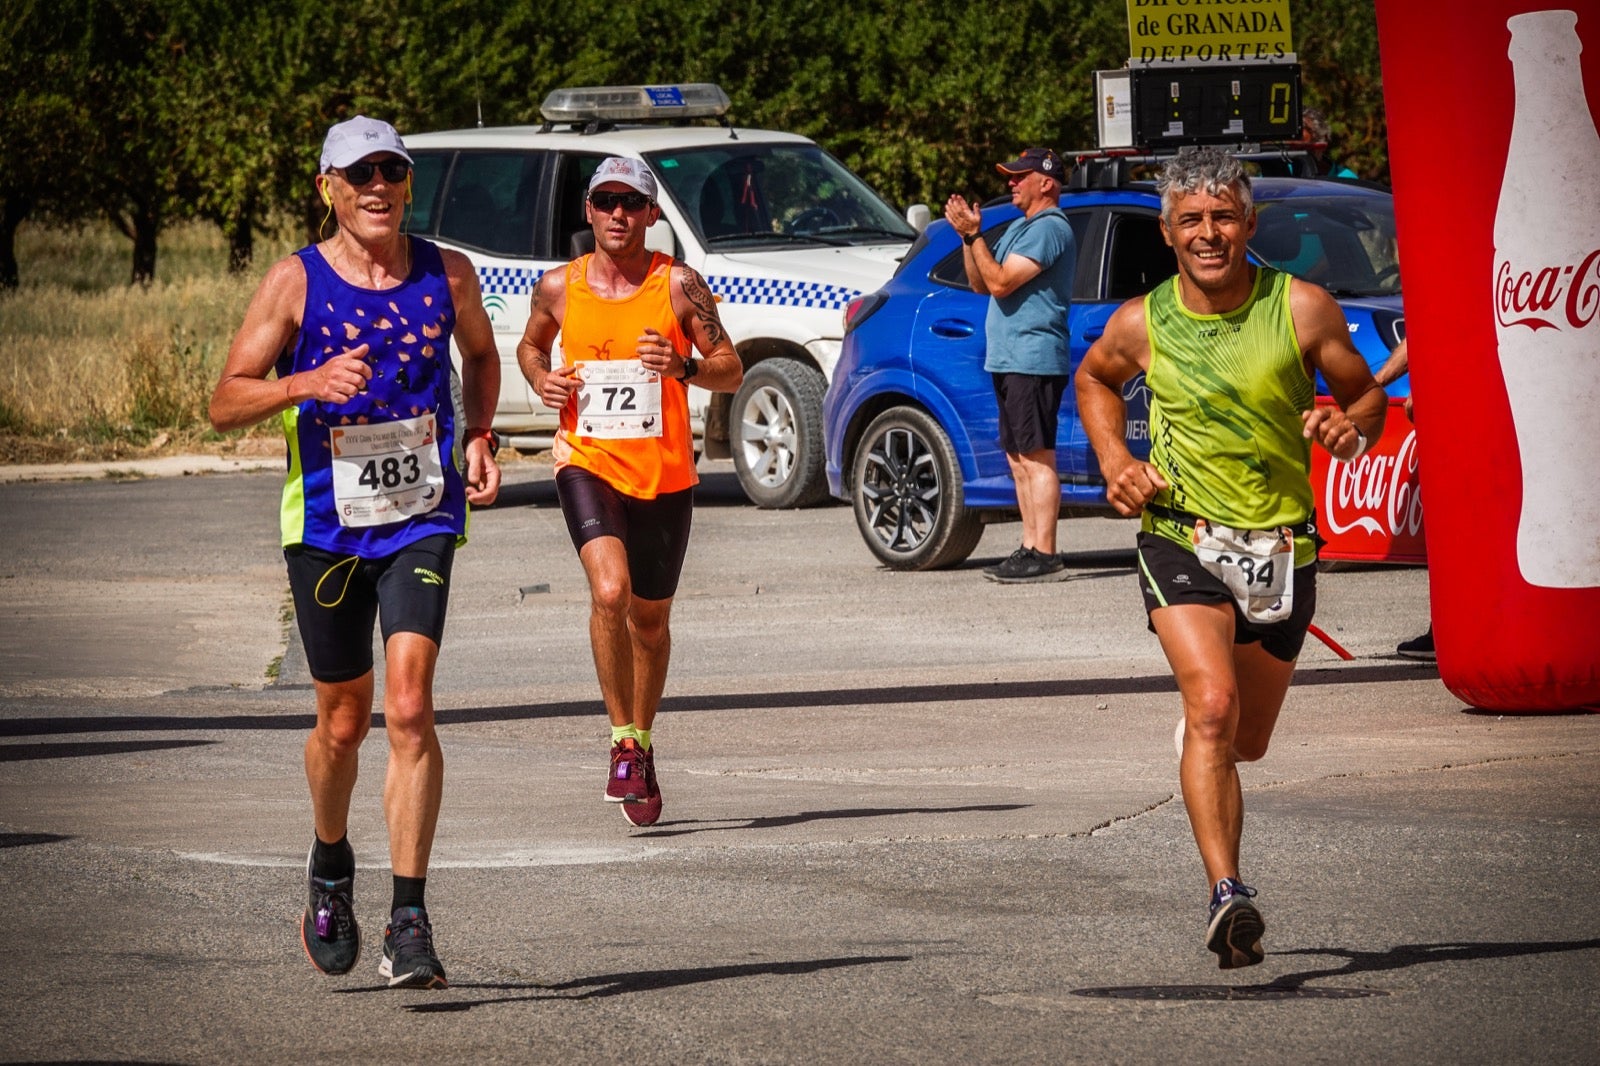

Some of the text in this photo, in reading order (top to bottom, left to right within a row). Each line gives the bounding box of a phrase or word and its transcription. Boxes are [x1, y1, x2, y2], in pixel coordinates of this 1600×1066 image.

[1137, 11, 1284, 36] de GRANADA
[1140, 42, 1285, 64] DEPORTES
[602, 387, 636, 410] 72
[358, 454, 420, 490] 483
